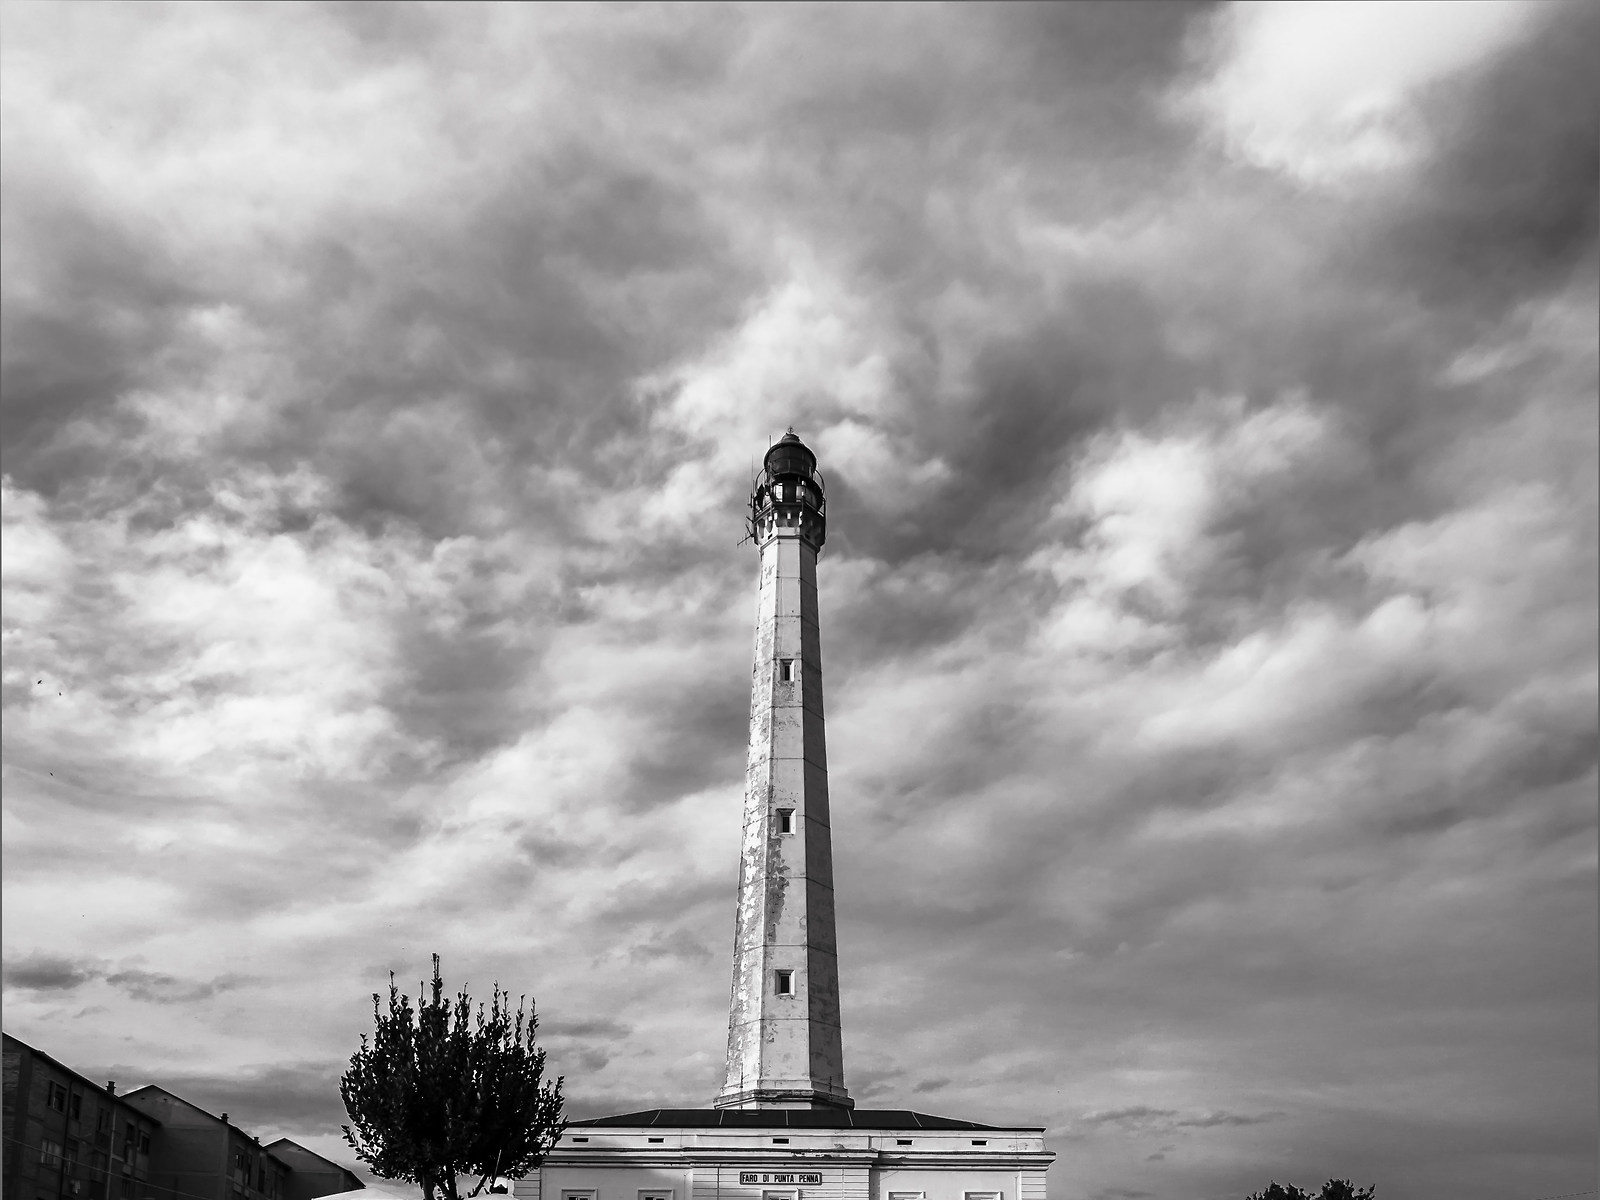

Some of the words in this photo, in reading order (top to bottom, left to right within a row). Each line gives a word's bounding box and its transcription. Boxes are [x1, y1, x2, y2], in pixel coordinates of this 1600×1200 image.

[742, 1174, 758, 1183] FARO
[763, 1174, 770, 1183] DI
[774, 1174, 795, 1183] PUNTA
[799, 1174, 819, 1183] PENNA
